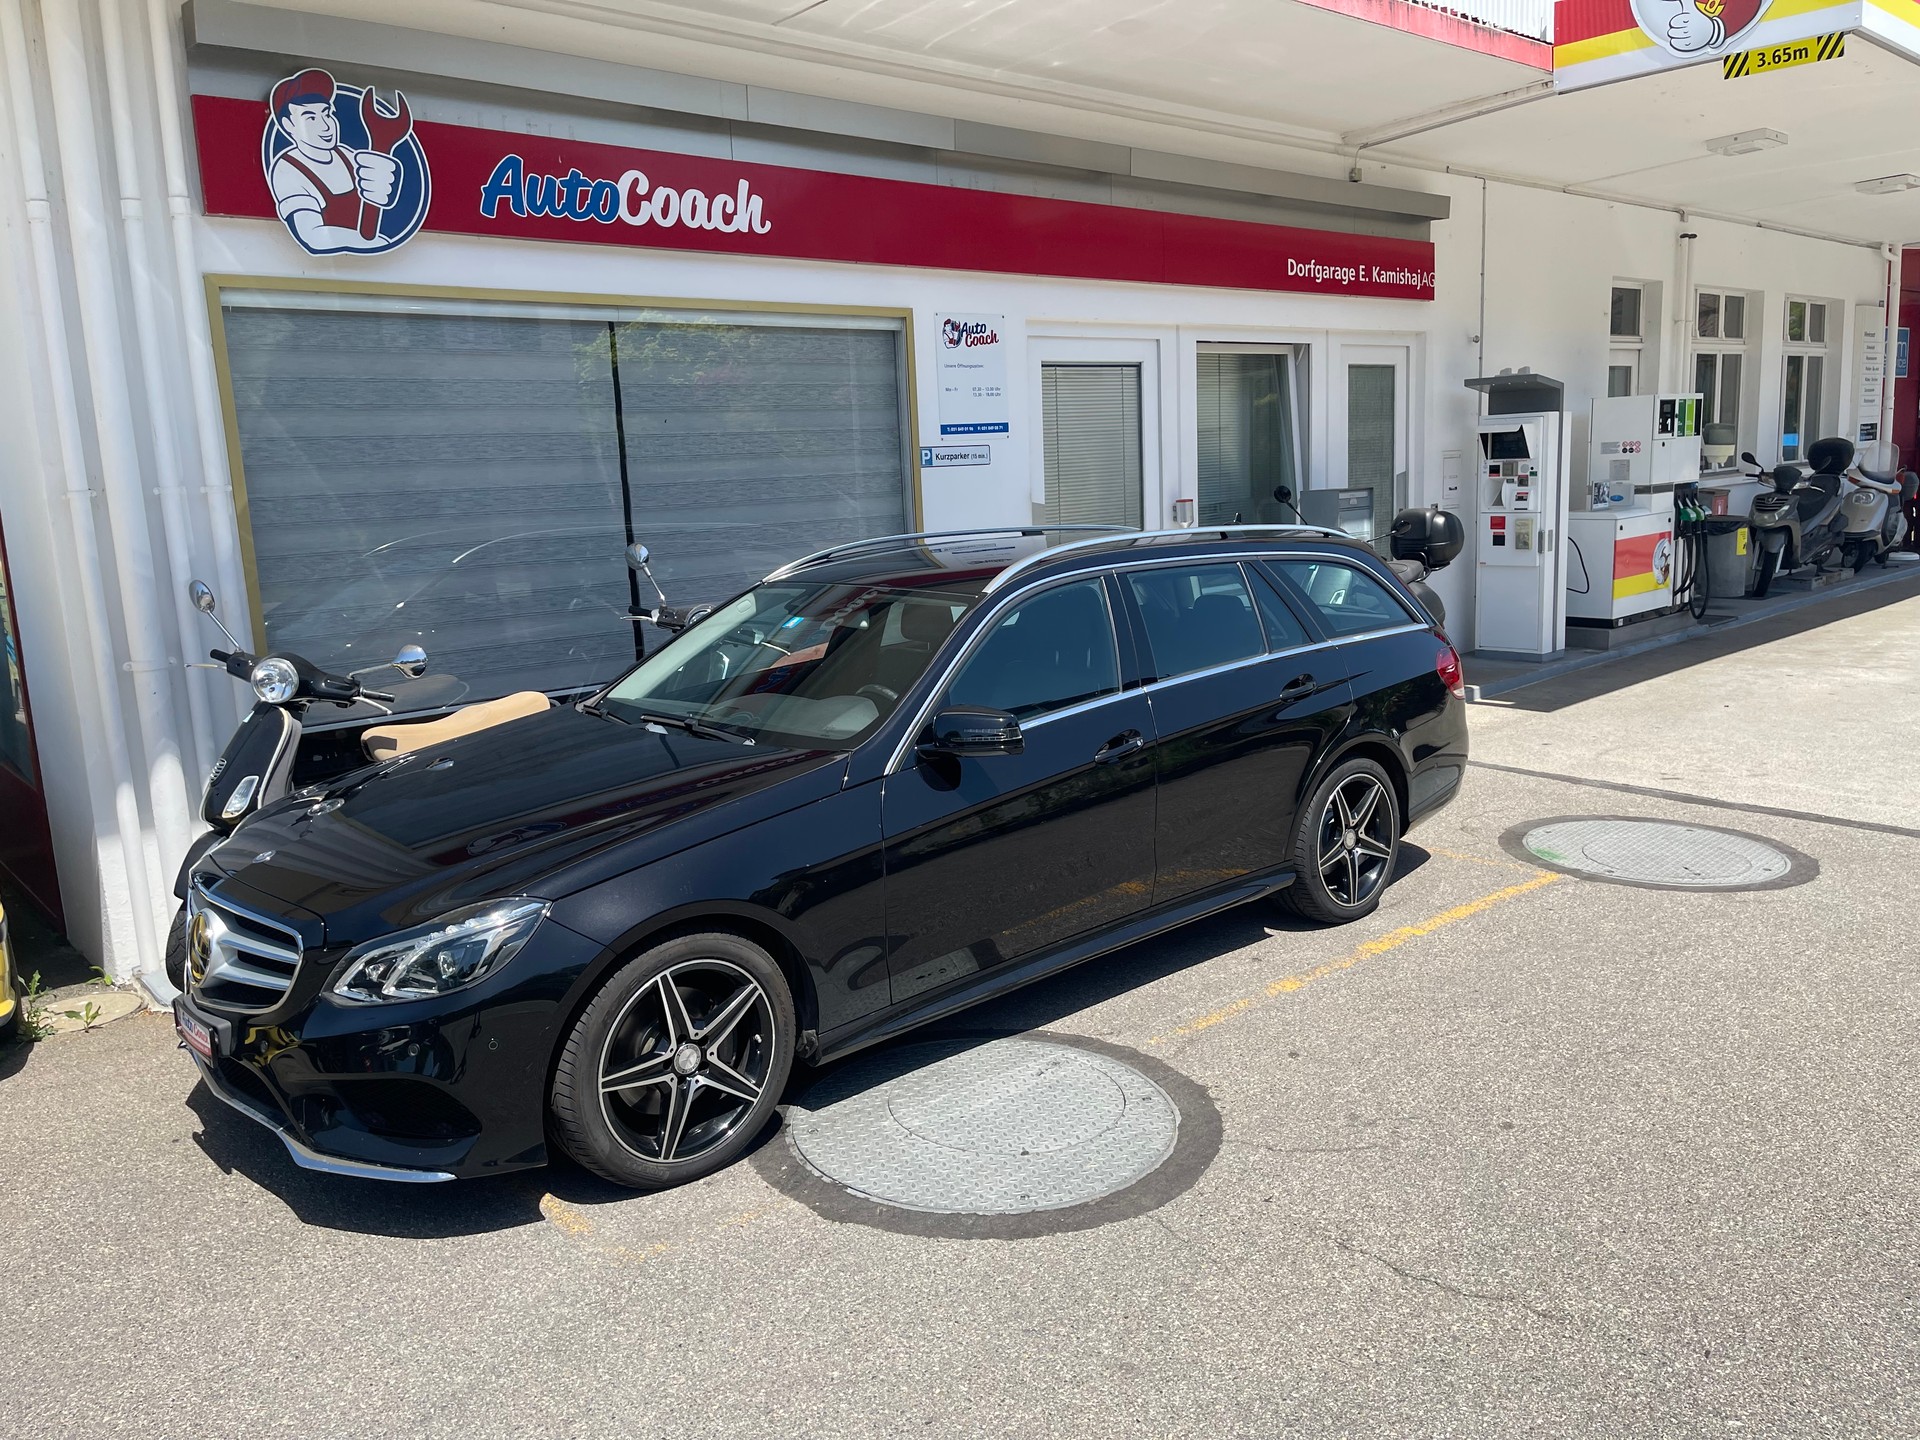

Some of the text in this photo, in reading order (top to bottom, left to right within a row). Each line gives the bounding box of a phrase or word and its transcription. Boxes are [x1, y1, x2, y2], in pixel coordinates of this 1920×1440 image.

[1757, 46, 1809, 68] 3.65m
[1287, 258, 1356, 285] Dorfgarage
[1359, 265, 1369, 282] E.
[1372, 266, 1421, 290] Kamishaj
[961, 321, 987, 338] Auto
[965, 329, 1000, 348] Coach
[935, 452, 970, 462] Kurzparker
